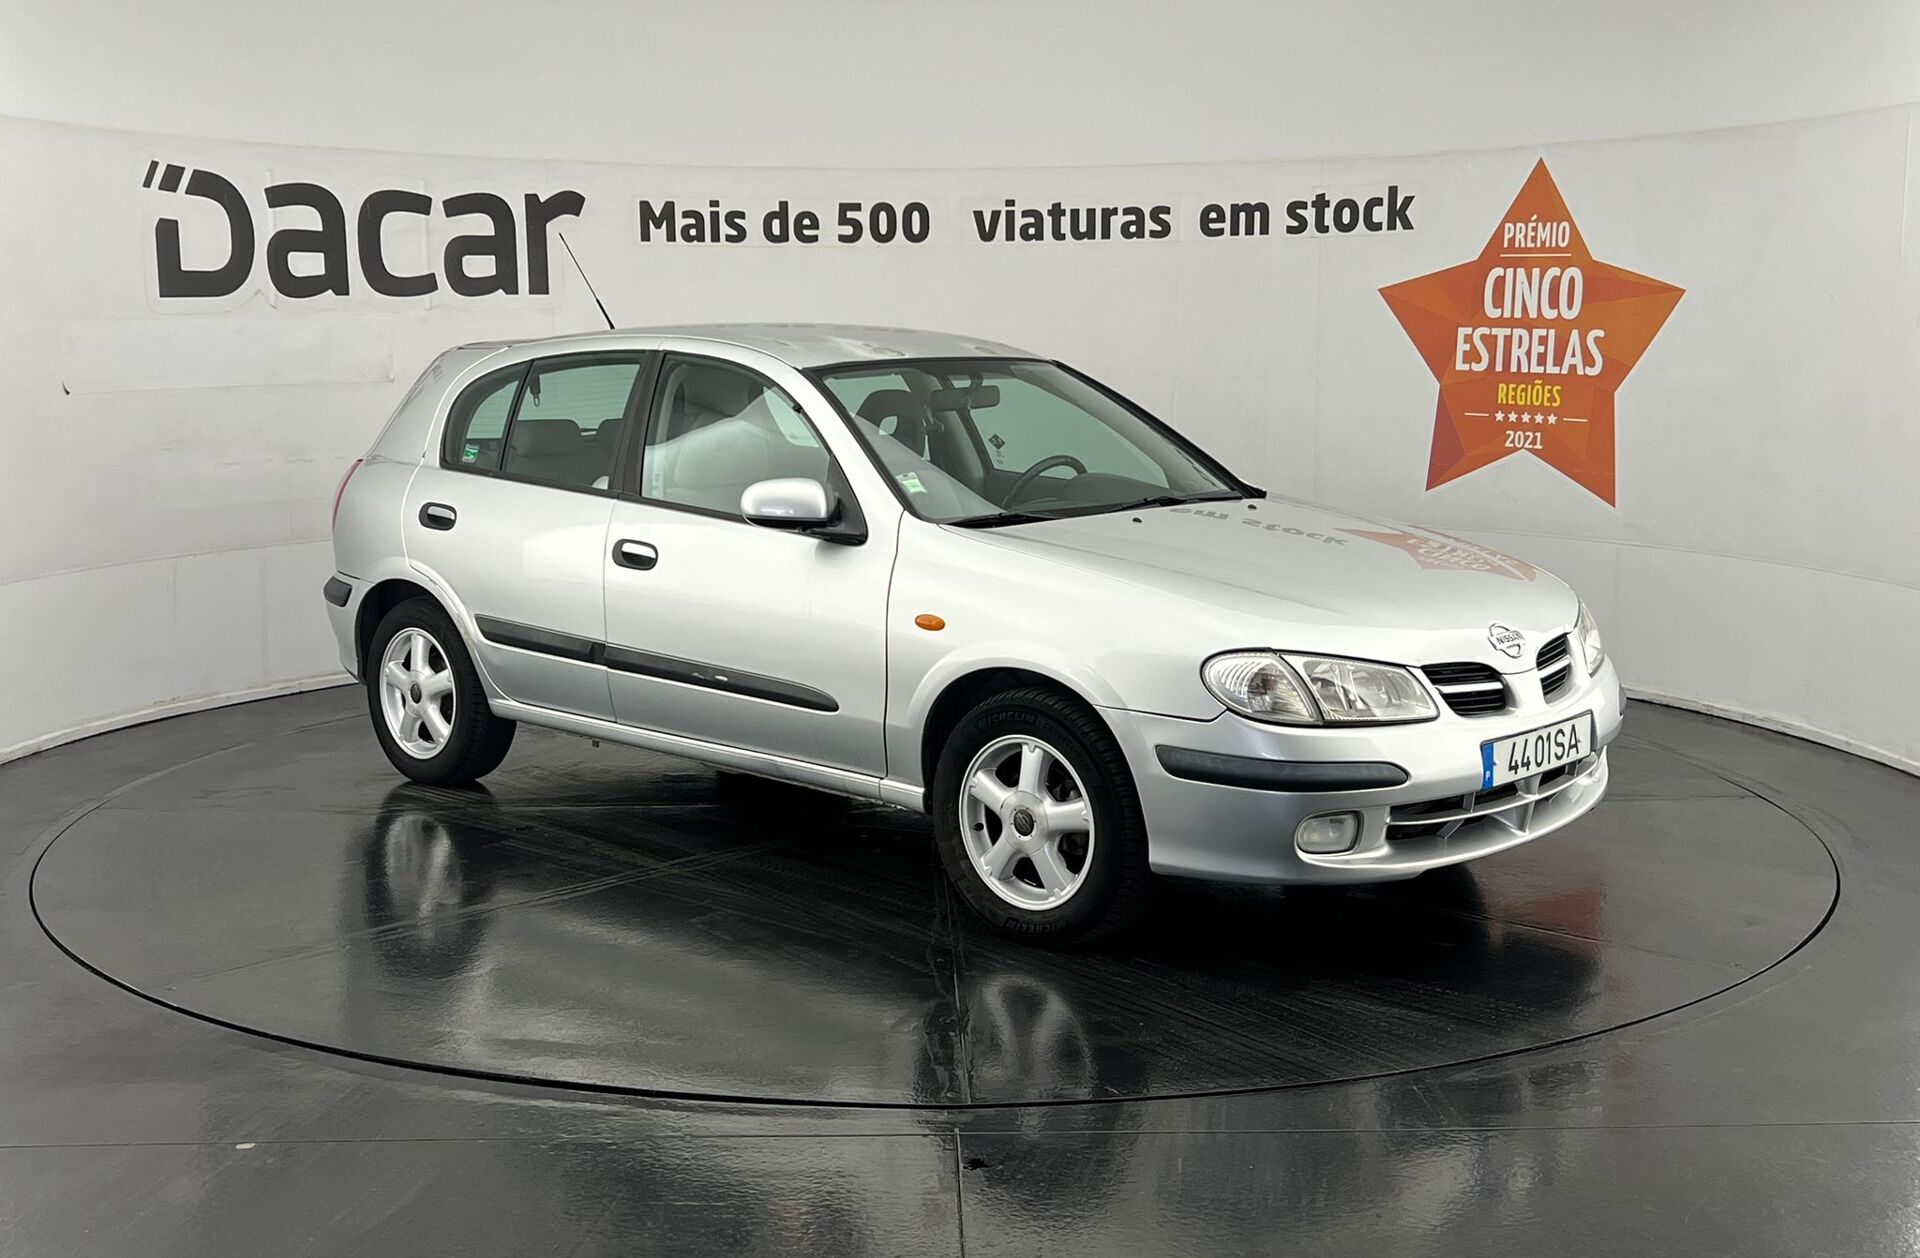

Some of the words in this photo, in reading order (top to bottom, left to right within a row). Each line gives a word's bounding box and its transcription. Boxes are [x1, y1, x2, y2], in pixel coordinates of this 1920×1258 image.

[143, 160, 585, 298] Dacar
[639, 200, 747, 243] Mais
[762, 201, 820, 243] de
[837, 202, 930, 243] 500
[973, 199, 1171, 242] viaturas
[1200, 202, 1269, 237] em
[1286, 186, 1415, 235] stock
[1503, 214, 1570, 248] PRÉMIO
[1484, 267, 1583, 320] CINCO
[1455, 327, 1605, 377] ESTRELAS
[1497, 380, 1562, 407] REGIÕES
[1504, 430, 1543, 449] 2021
[1496, 632, 1522, 645] NISSAN
[977, 711, 1037, 728] MICHELIN
